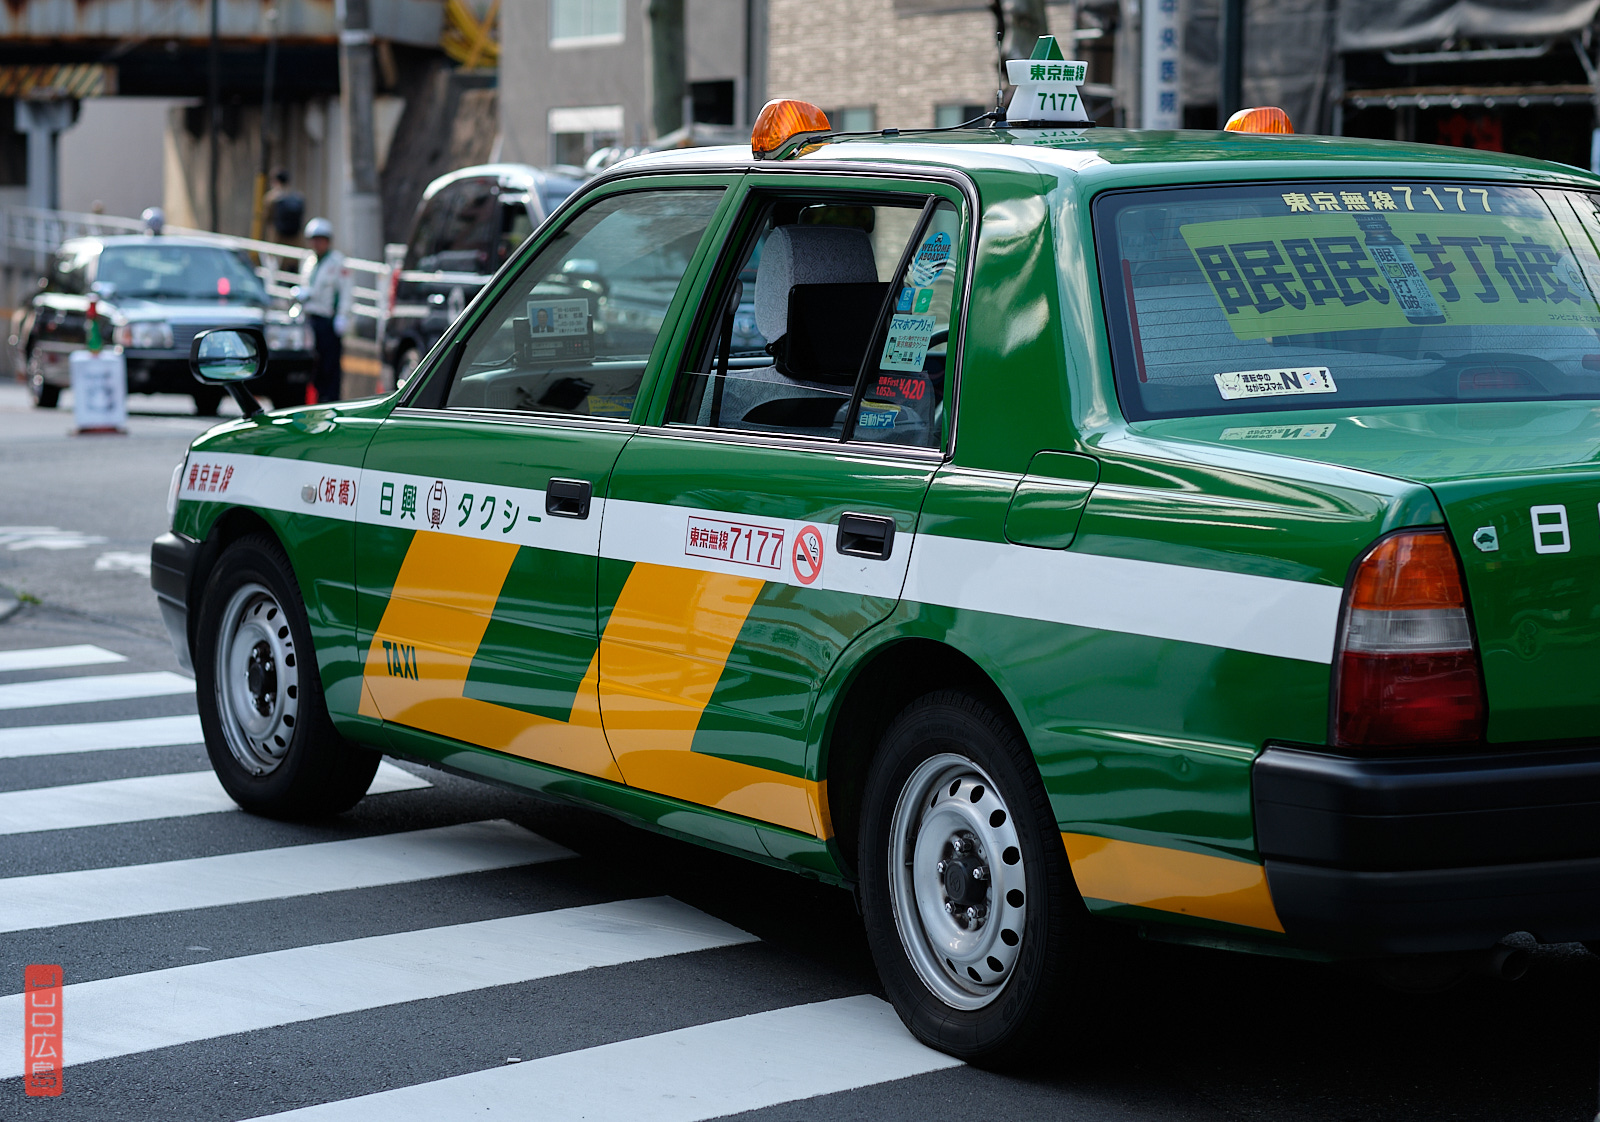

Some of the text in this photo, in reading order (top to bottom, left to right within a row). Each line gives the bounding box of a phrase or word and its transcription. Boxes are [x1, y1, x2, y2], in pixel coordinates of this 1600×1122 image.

[1030, 64, 1085, 81] 東京無線
[1038, 93, 1078, 111] 7177
[921, 244, 952, 253] WELCOME
[1241, 374, 1271, 383] 運転中の
[1245, 382, 1284, 393] ながらスマホ
[859, 413, 892, 426] 自動ドア
[187, 464, 234, 493] 東京無線
[458, 493, 542, 534] タクシー
[382, 640, 419, 681] TAXI
